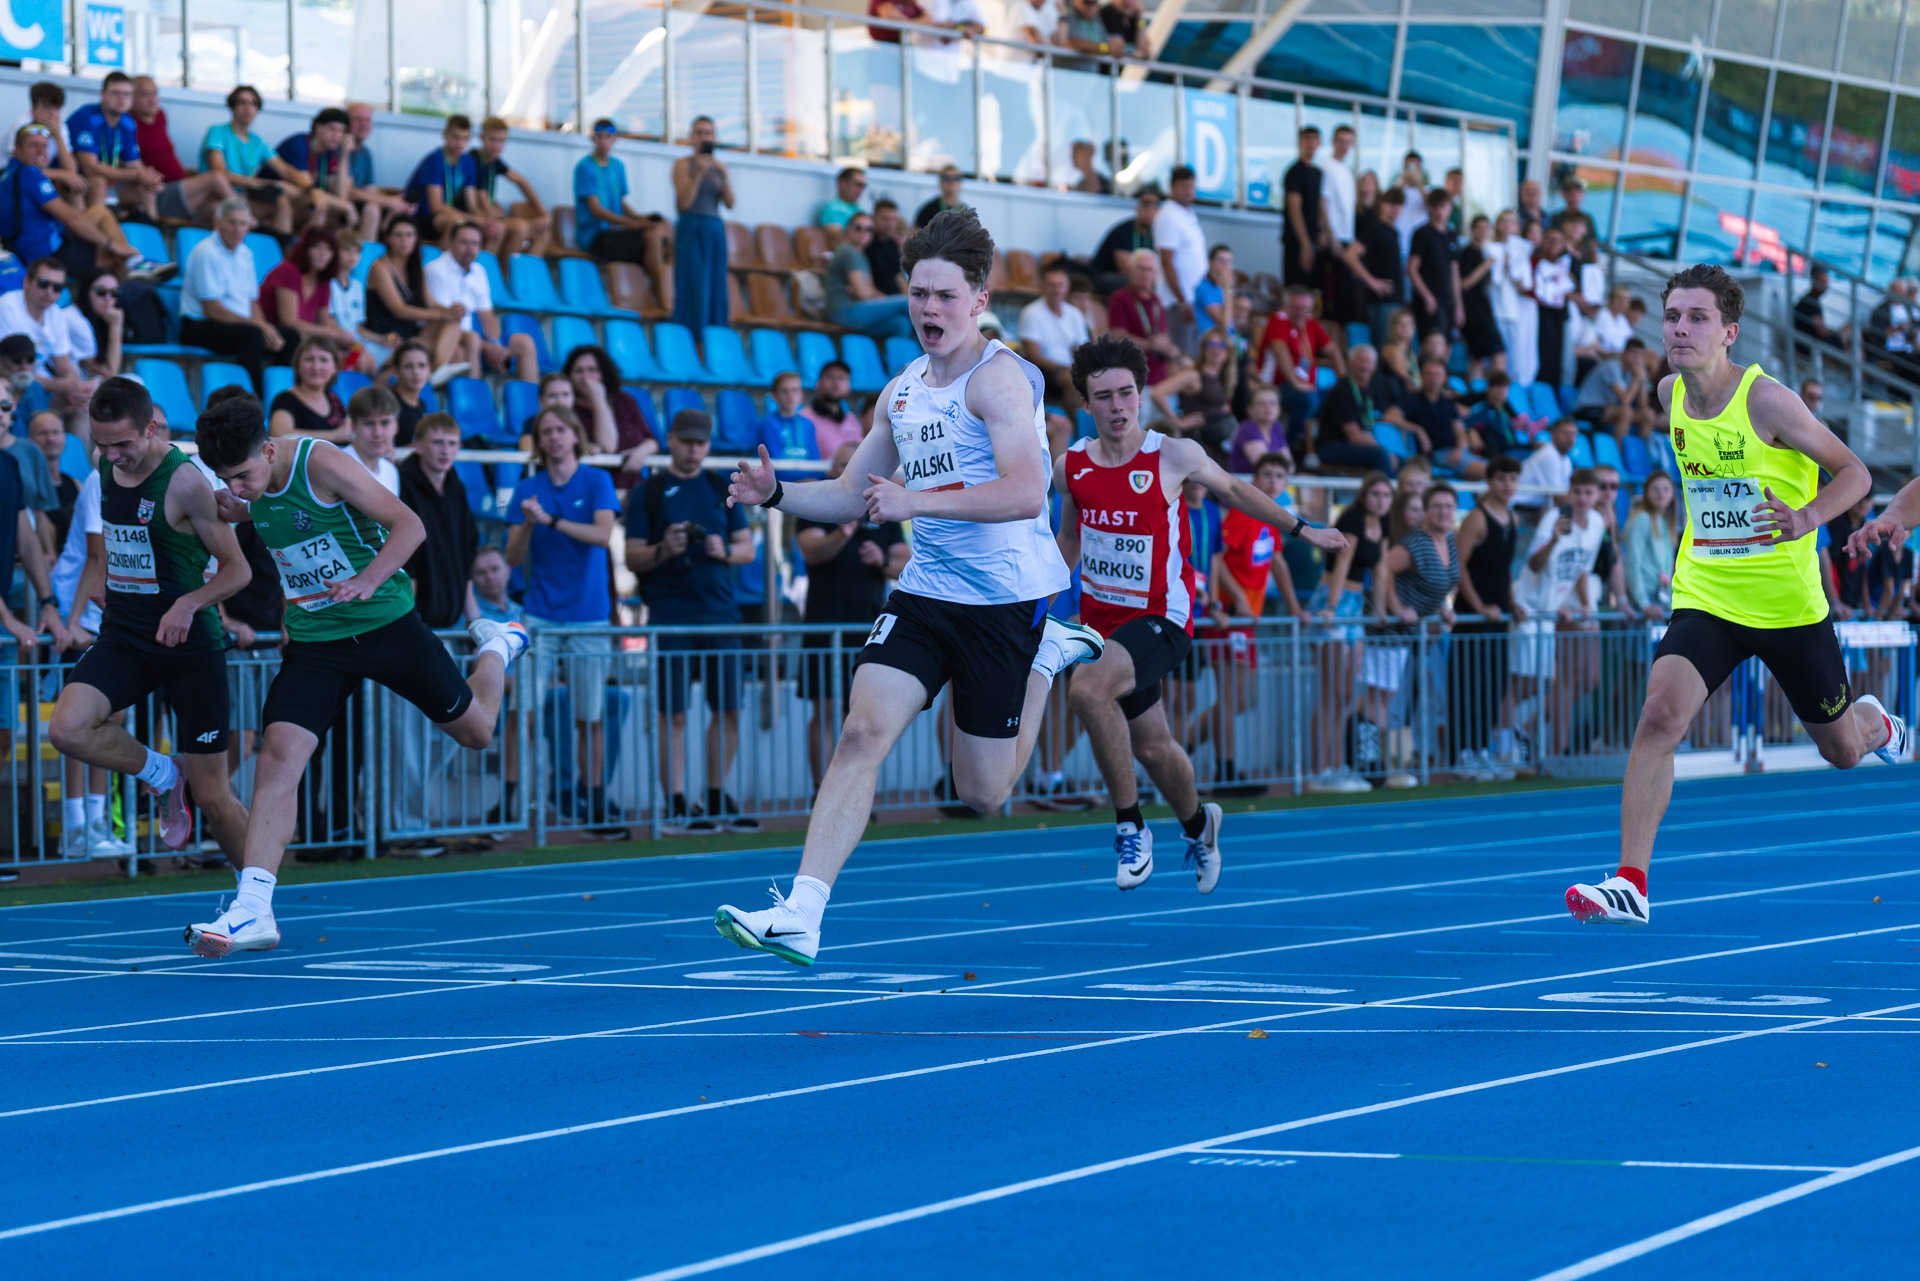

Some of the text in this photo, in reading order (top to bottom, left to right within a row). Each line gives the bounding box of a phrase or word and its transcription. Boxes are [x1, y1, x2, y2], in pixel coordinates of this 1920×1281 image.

[87, 8, 124, 43] WC
[1195, 121, 1226, 191] D
[921, 421, 945, 442] 811
[1723, 483, 1754, 498] 471
[1082, 509, 1138, 526] PIAST
[1701, 509, 1750, 529] CISAK
[114, 529, 148, 543] 1148
[1114, 537, 1145, 553] 890
[301, 538, 330, 559] 173
[285, 558, 347, 589] BORYGA
[1083, 553, 1144, 581] KARKUS
[871, 616, 883, 641] 4
[196, 729, 219, 743] 4F
